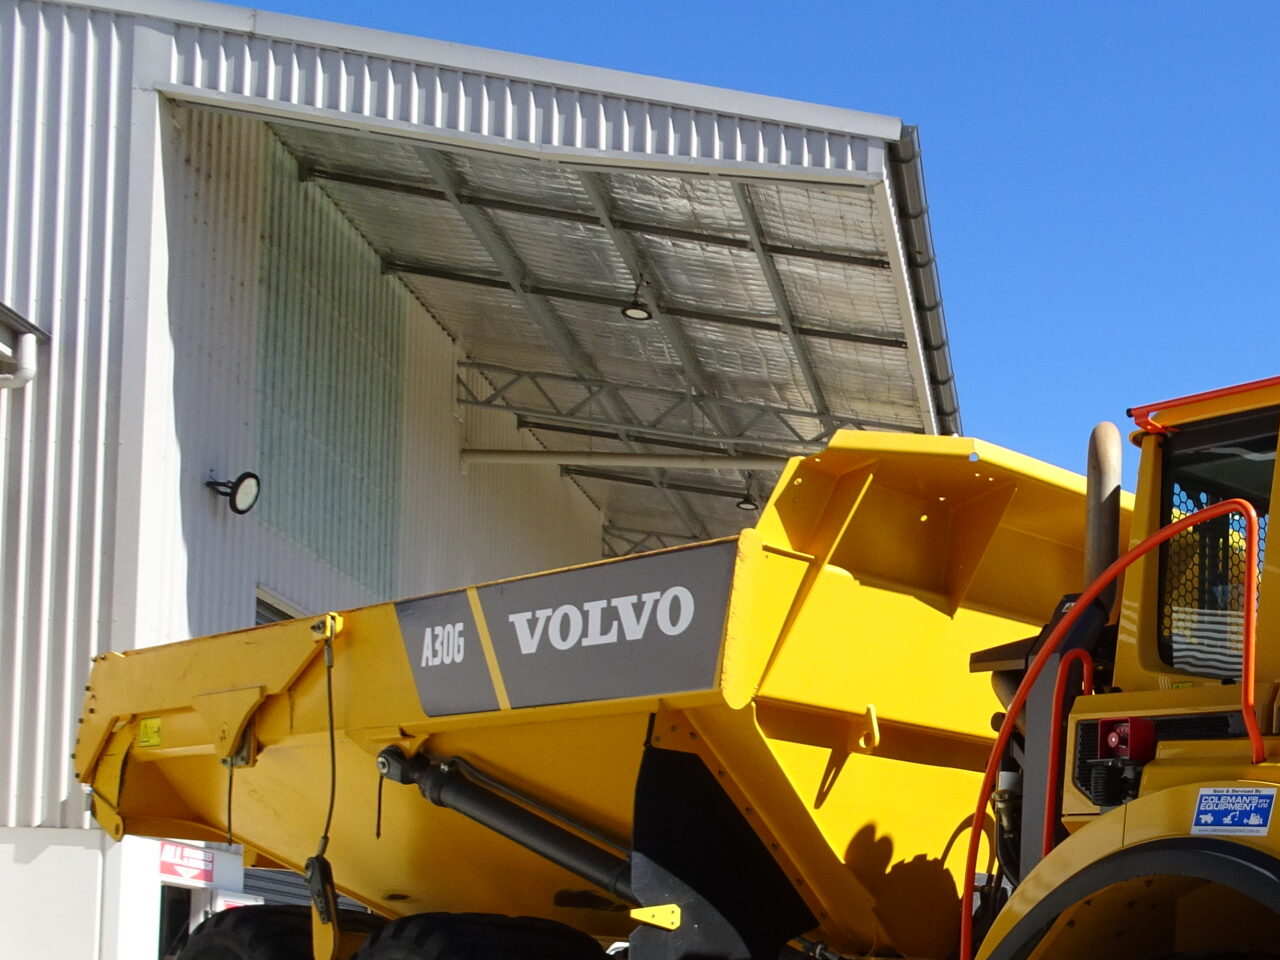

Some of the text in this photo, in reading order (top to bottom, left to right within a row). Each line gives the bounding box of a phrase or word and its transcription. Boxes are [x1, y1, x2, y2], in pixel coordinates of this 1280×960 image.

[508, 585, 695, 655] VOLVO
[420, 622, 465, 667] A30G
[1199, 803, 1258, 811] EQUIPMENT
[1201, 796, 1259, 804] COLEMAN'S
